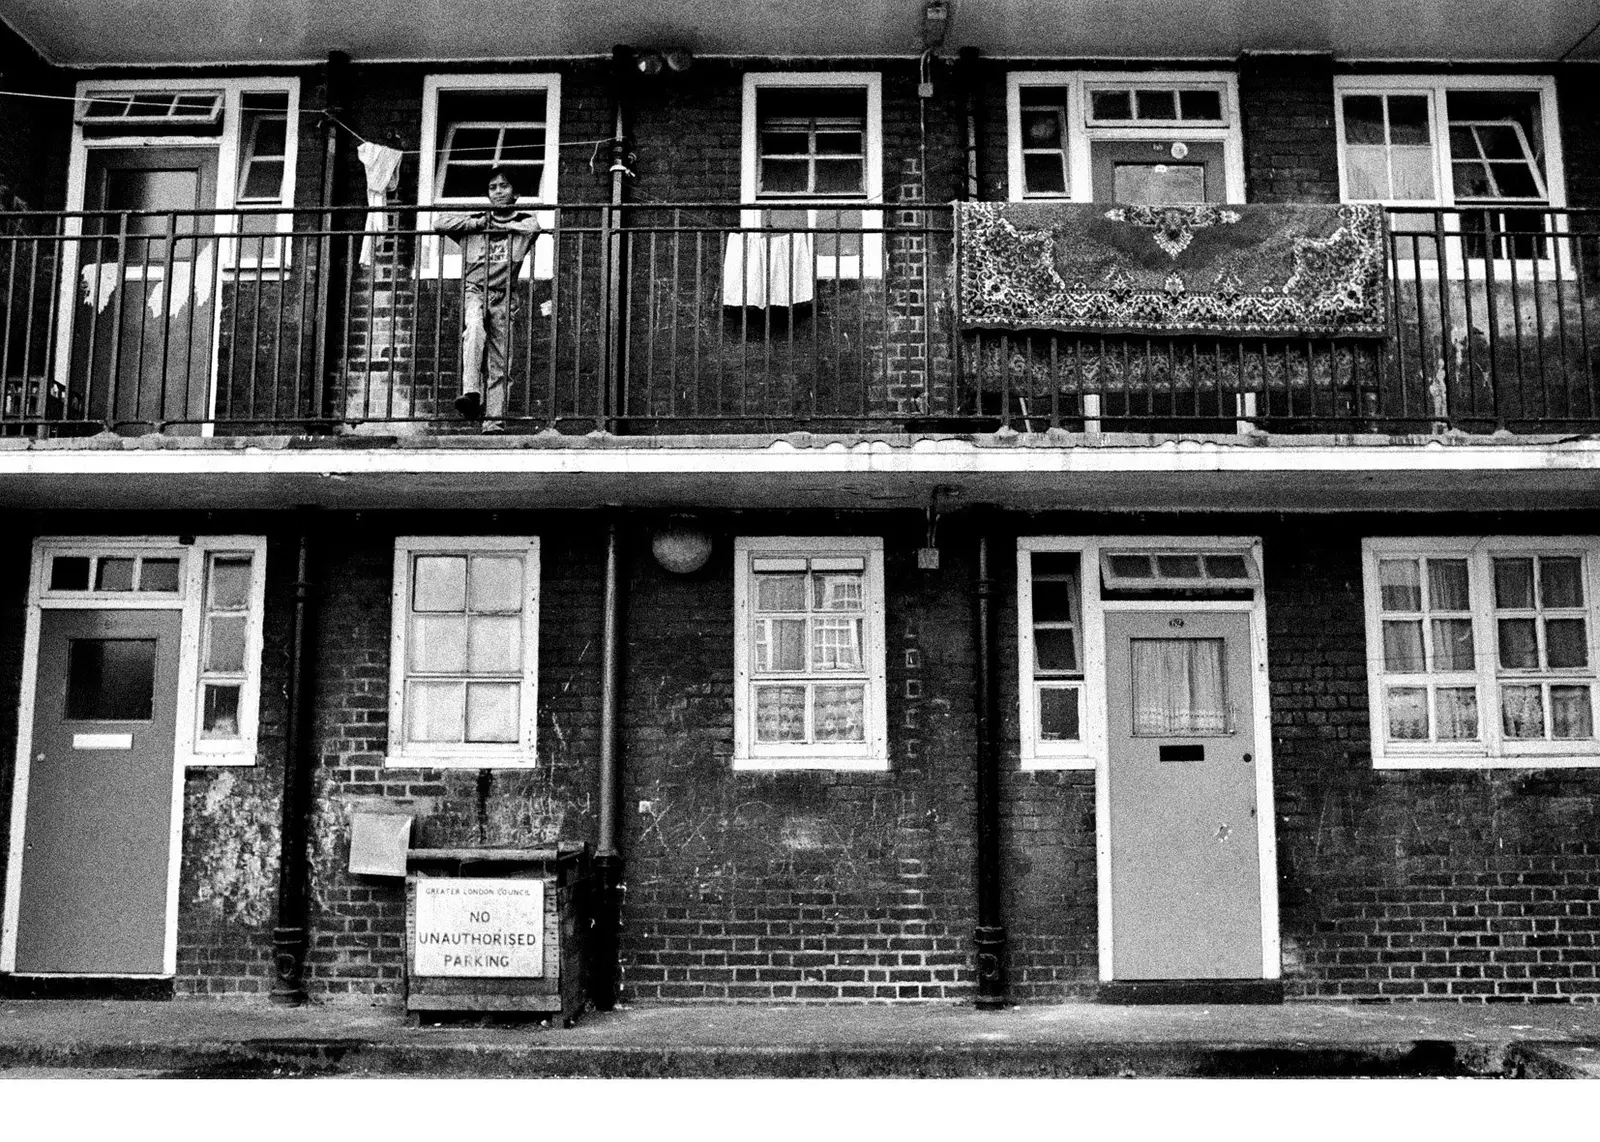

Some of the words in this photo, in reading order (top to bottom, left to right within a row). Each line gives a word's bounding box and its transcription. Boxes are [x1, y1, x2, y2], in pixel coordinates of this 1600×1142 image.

[425, 887, 460, 896] GREATER
[463, 888, 494, 896] LONDON
[497, 887, 531, 897] COUNCIL
[469, 910, 491, 923] NO
[418, 931, 536, 946] UNAUTHORISED
[443, 953, 510, 968] PARKING
